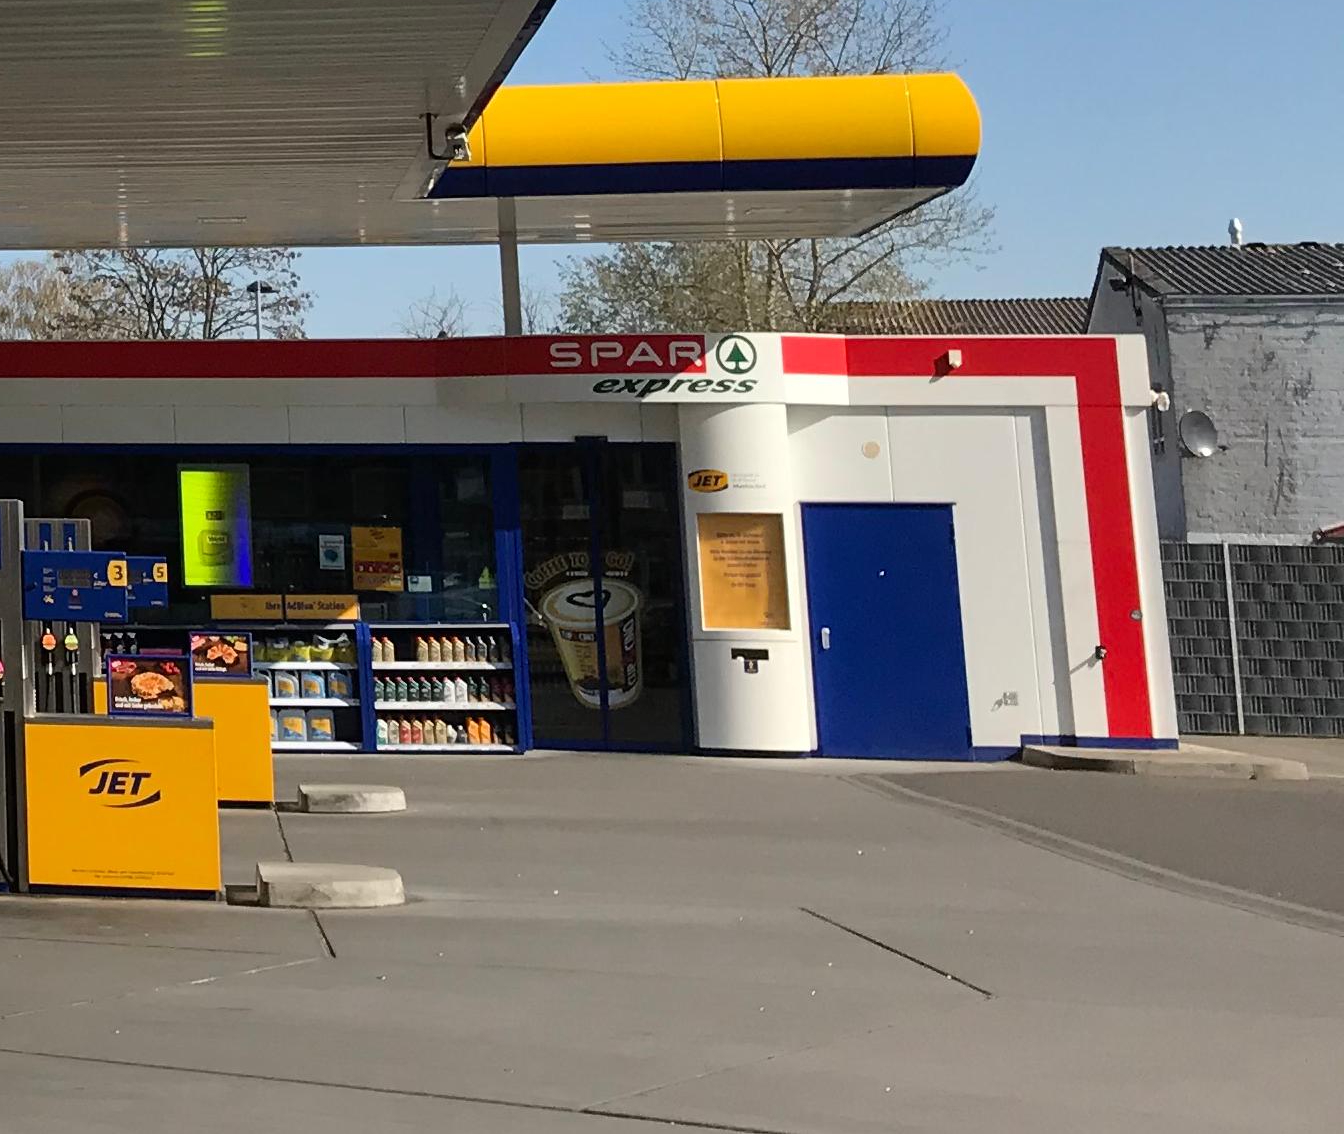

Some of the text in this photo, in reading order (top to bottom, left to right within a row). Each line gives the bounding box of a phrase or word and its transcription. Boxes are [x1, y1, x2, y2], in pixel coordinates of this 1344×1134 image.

[549, 341, 703, 368] SPAR
[592, 377, 759, 399] express
[693, 474, 725, 487] JET
[570, 552, 588, 566] TO
[113, 565, 123, 581] 3
[156, 566, 164, 578] 5
[317, 601, 346, 610] Station
[89, 771, 152, 795] JET
